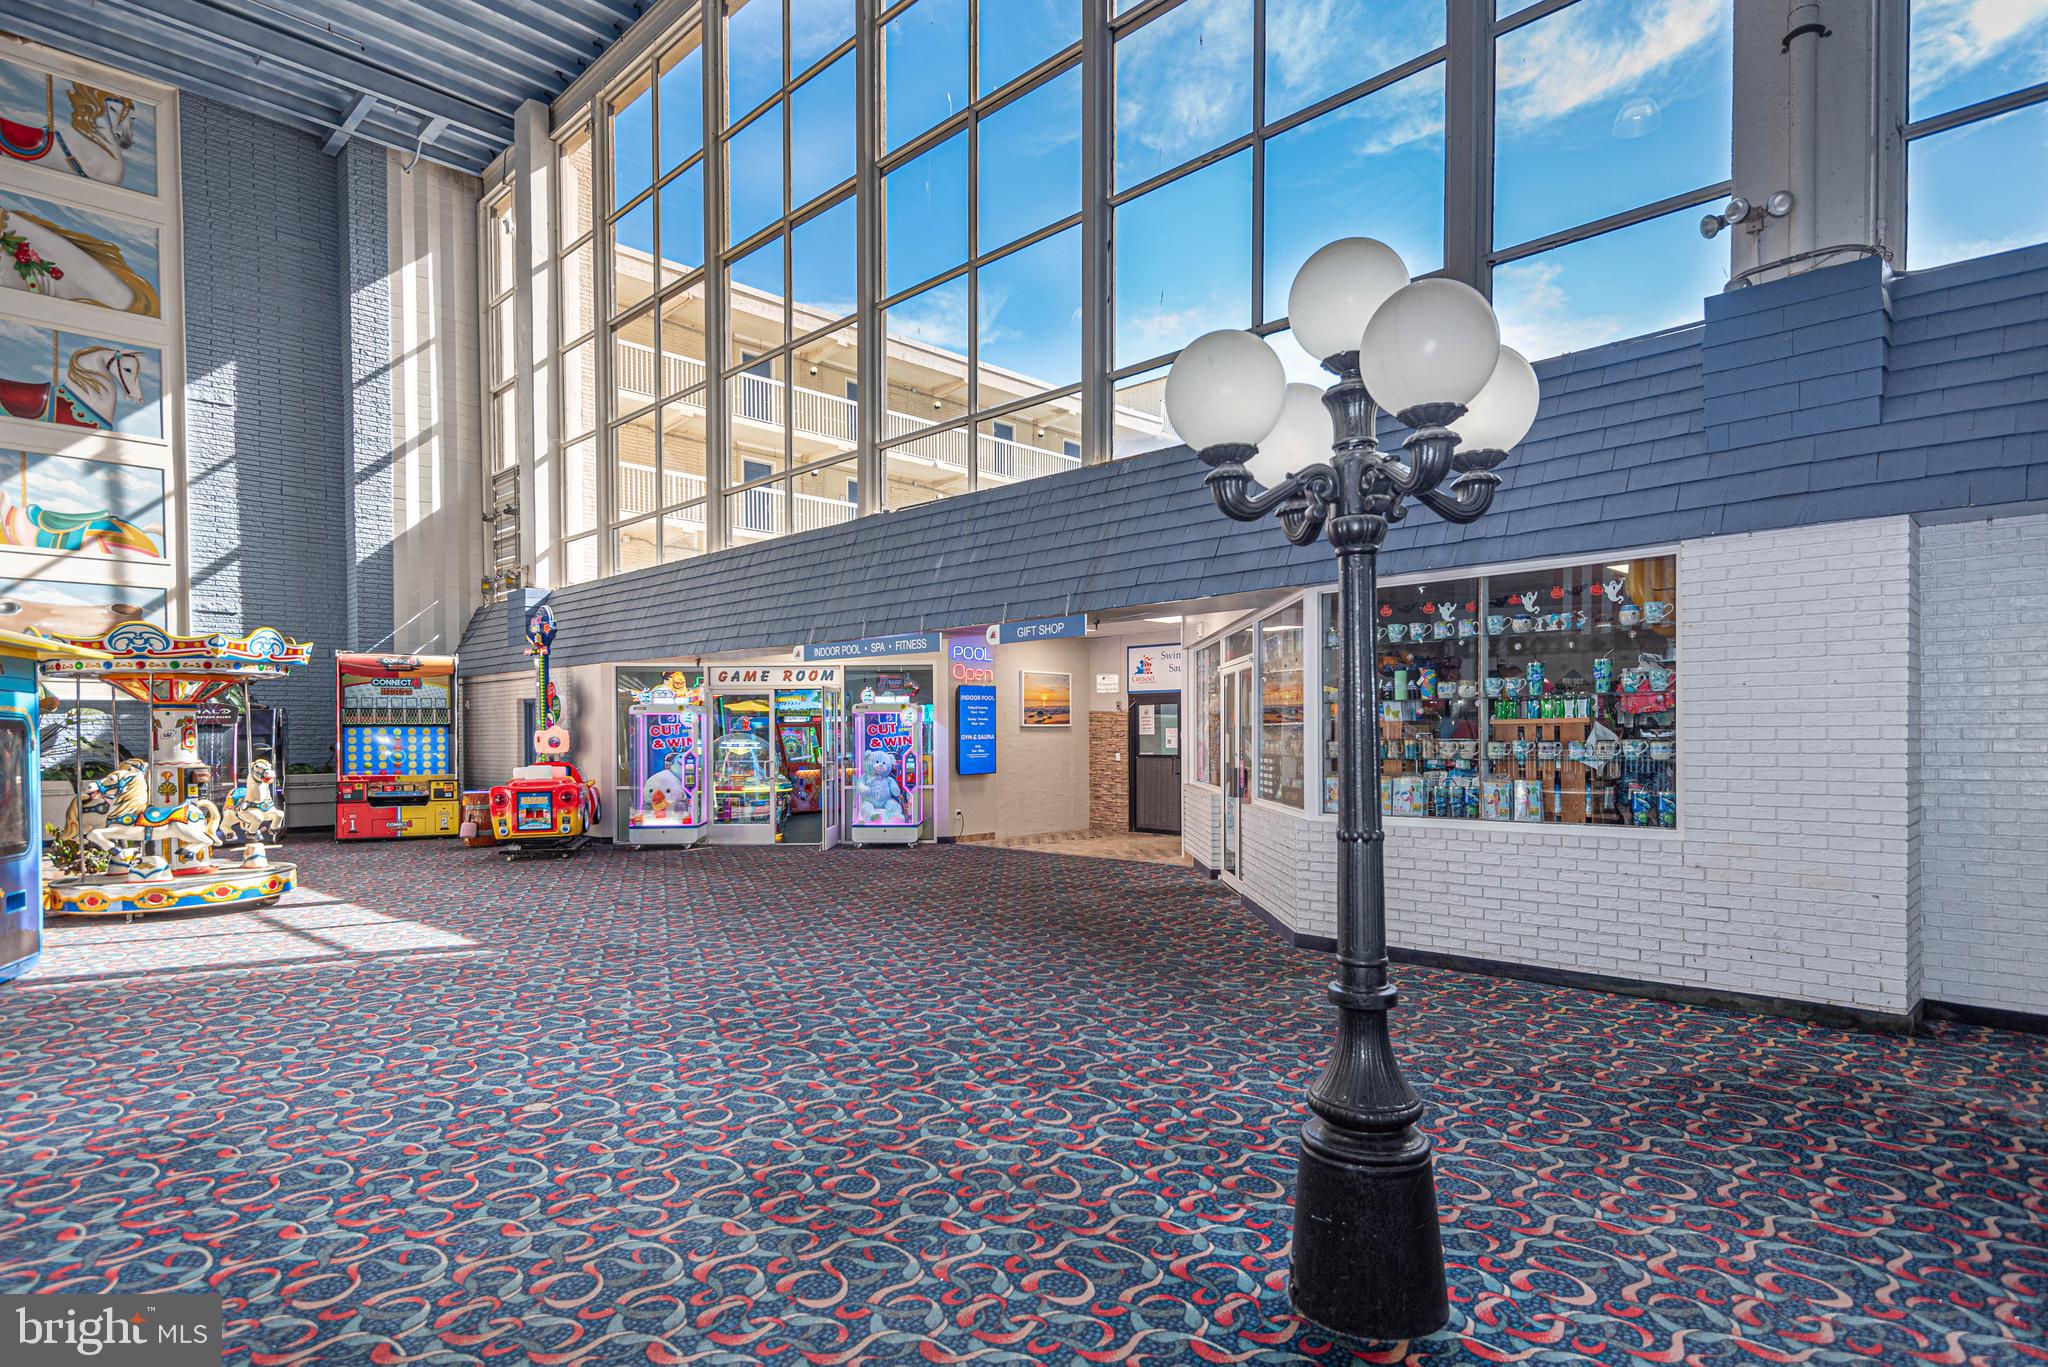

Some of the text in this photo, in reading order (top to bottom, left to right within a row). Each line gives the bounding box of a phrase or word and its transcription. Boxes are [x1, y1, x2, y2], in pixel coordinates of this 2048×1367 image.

[1017, 622, 1064, 638] GIFT SHOP
[813, 638, 927, 657] INDOOR POOL SPA FITNESS
[953, 645, 993, 661] POOL
[718, 669, 835, 682] GAME ROOM
[953, 663, 994, 683] Open
[411, 678, 420, 688] 4
[650, 724, 681, 736] CUT
[867, 722, 897, 735] CUT
[653, 739, 665, 749] &
[870, 736, 912, 748] & WIN
